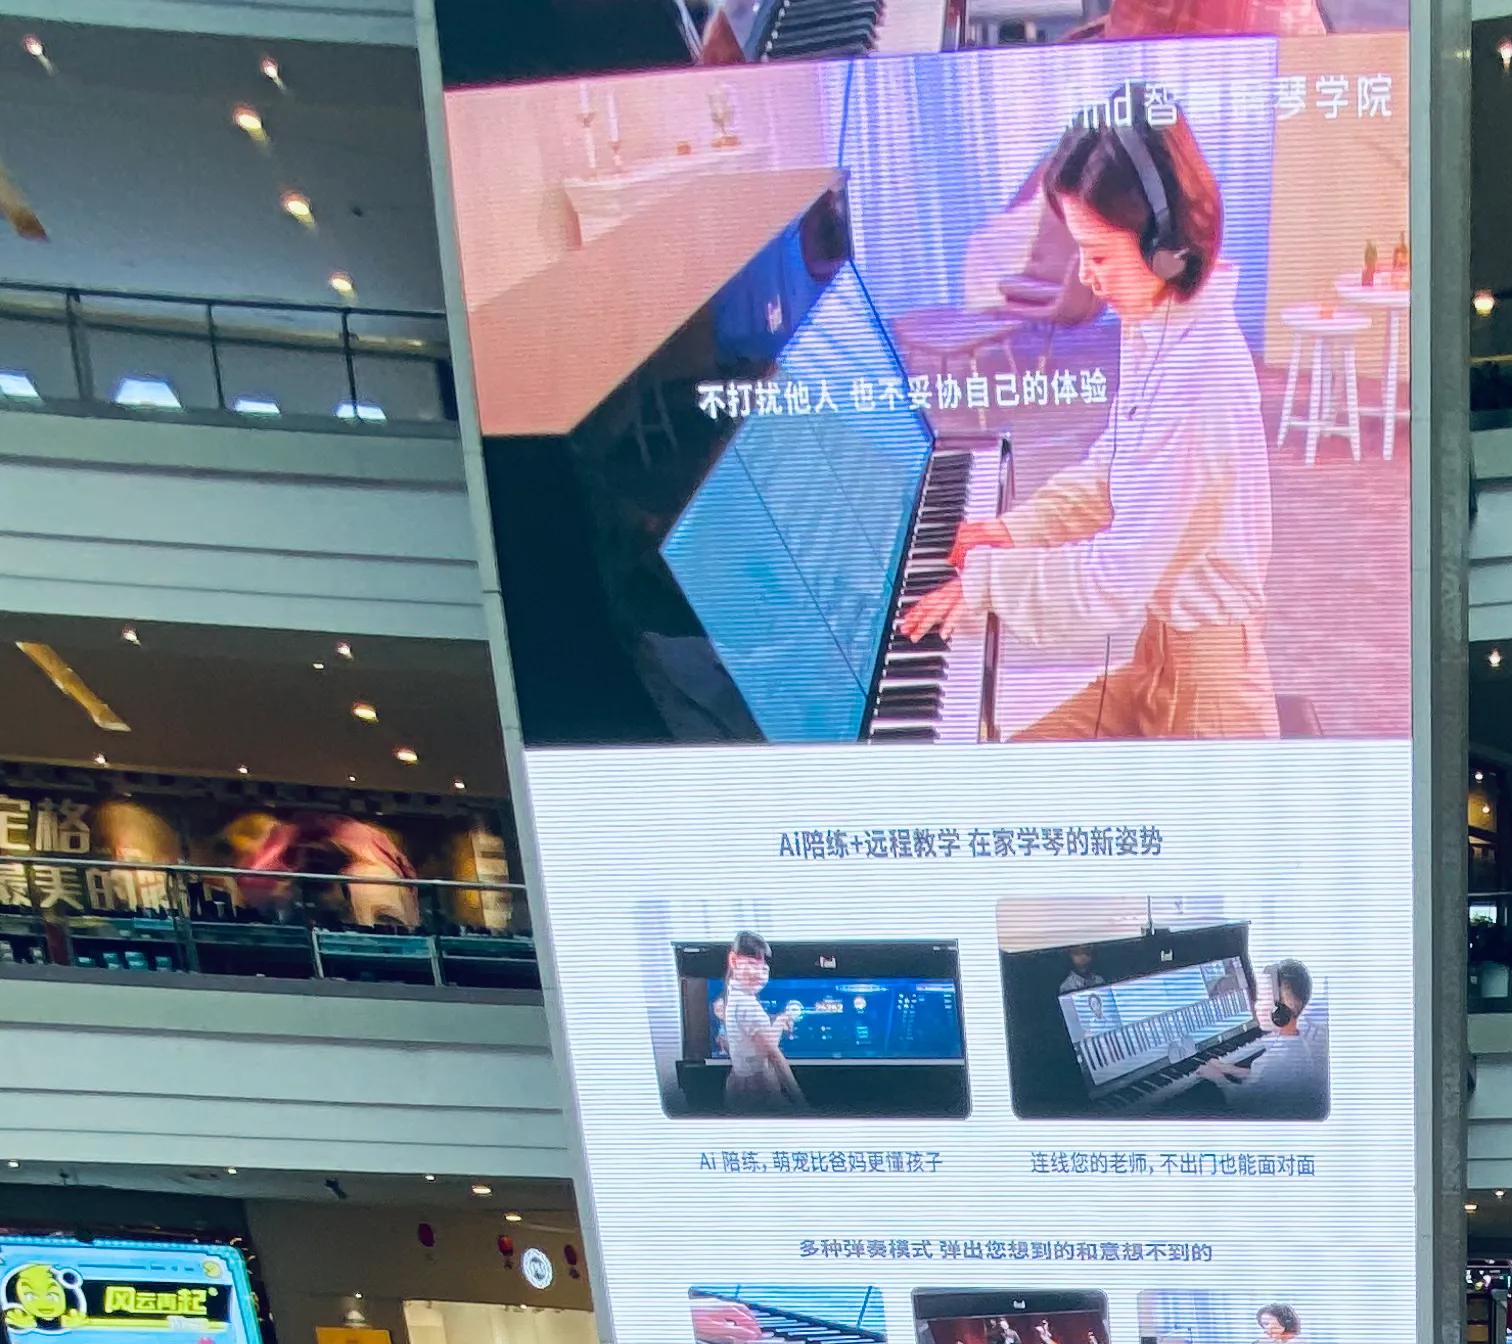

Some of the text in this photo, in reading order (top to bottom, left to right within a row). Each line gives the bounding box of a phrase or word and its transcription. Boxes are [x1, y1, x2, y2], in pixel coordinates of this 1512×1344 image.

[698, 367, 1108, 420] 不打扰他人 也不妥协自己的体验
[967, 825, 1164, 858] 在家学琴的新姿势
[799, 1238, 1213, 1263] 多种弹奏模式 弹出您想到的和意想不到的
